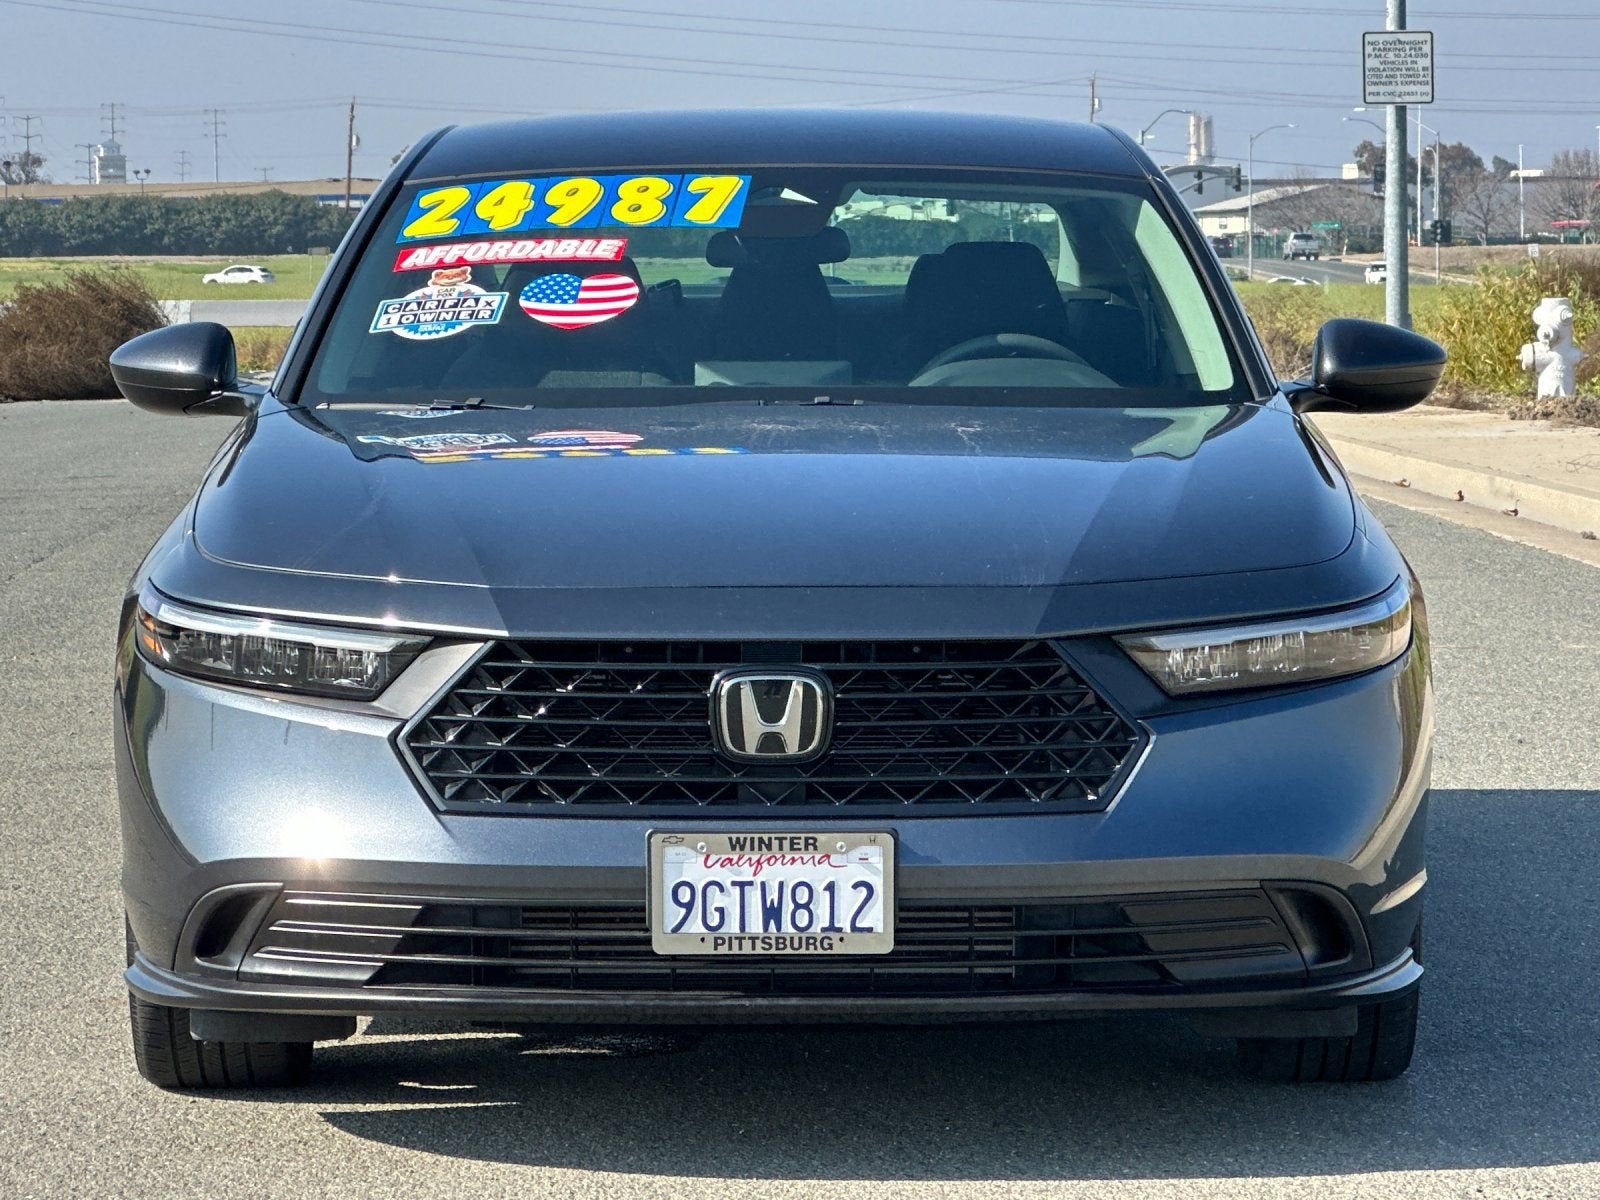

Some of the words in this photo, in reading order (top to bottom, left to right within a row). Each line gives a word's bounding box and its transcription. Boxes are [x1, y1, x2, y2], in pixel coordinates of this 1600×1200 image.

[402, 176, 745, 239] 24987
[405, 239, 622, 267] AFFORDABLE
[387, 298, 496, 314] CARFAX
[401, 310, 492, 325] OWNER
[727, 836, 819, 852] WINTER
[703, 853, 848, 877] California
[670, 880, 875, 934] 9GTW812
[713, 936, 834, 952] PITTSBURG
